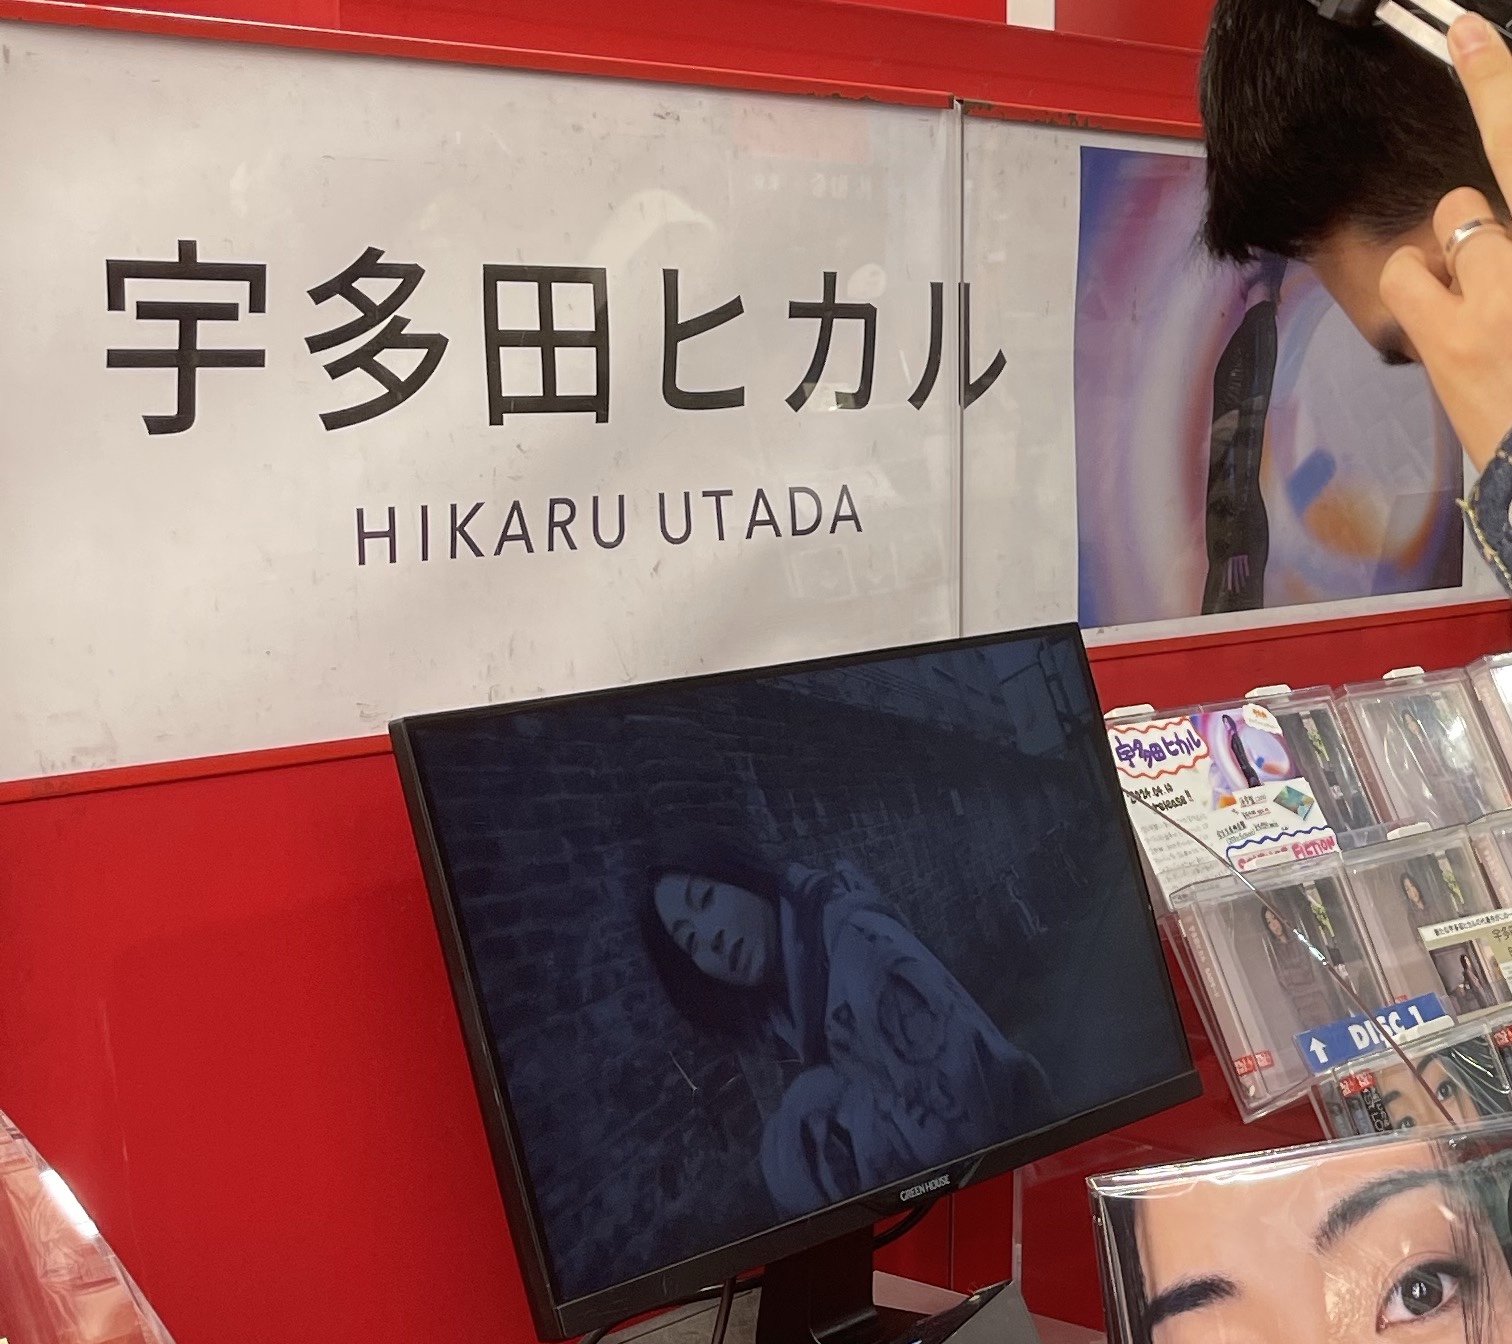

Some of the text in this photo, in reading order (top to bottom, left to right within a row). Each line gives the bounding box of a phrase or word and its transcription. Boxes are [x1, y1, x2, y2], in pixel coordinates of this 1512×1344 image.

[105, 239, 1007, 436] 宇多田ヒカル
[356, 484, 863, 566] HIKARU UTADA
[1114, 728, 1202, 769] 宇多田ヒカル
[1290, 836, 1336, 860] FICTION
[1348, 1005, 1426, 1051] DISC 1
[900, 1174, 951, 1202] GREEN HOUSE
